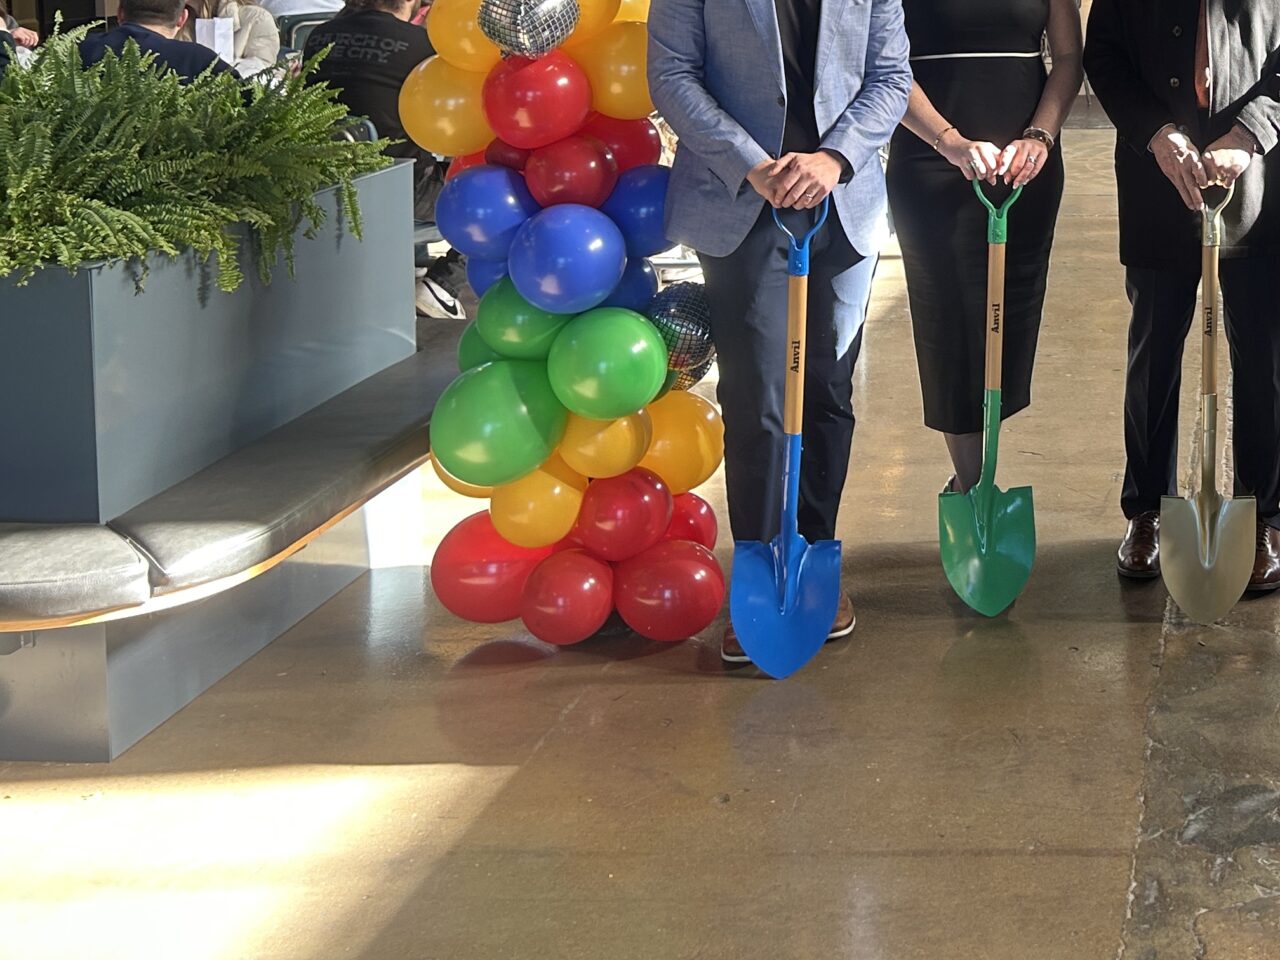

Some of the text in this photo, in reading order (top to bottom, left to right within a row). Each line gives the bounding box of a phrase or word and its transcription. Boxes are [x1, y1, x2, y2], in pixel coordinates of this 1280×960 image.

[347, 46, 391, 63] CITY
[380, 38, 409, 53] OF
[991, 303, 1000, 334] Anvil
[1204, 306, 1212, 337] Anvil
[790, 339, 800, 374] Anvil
